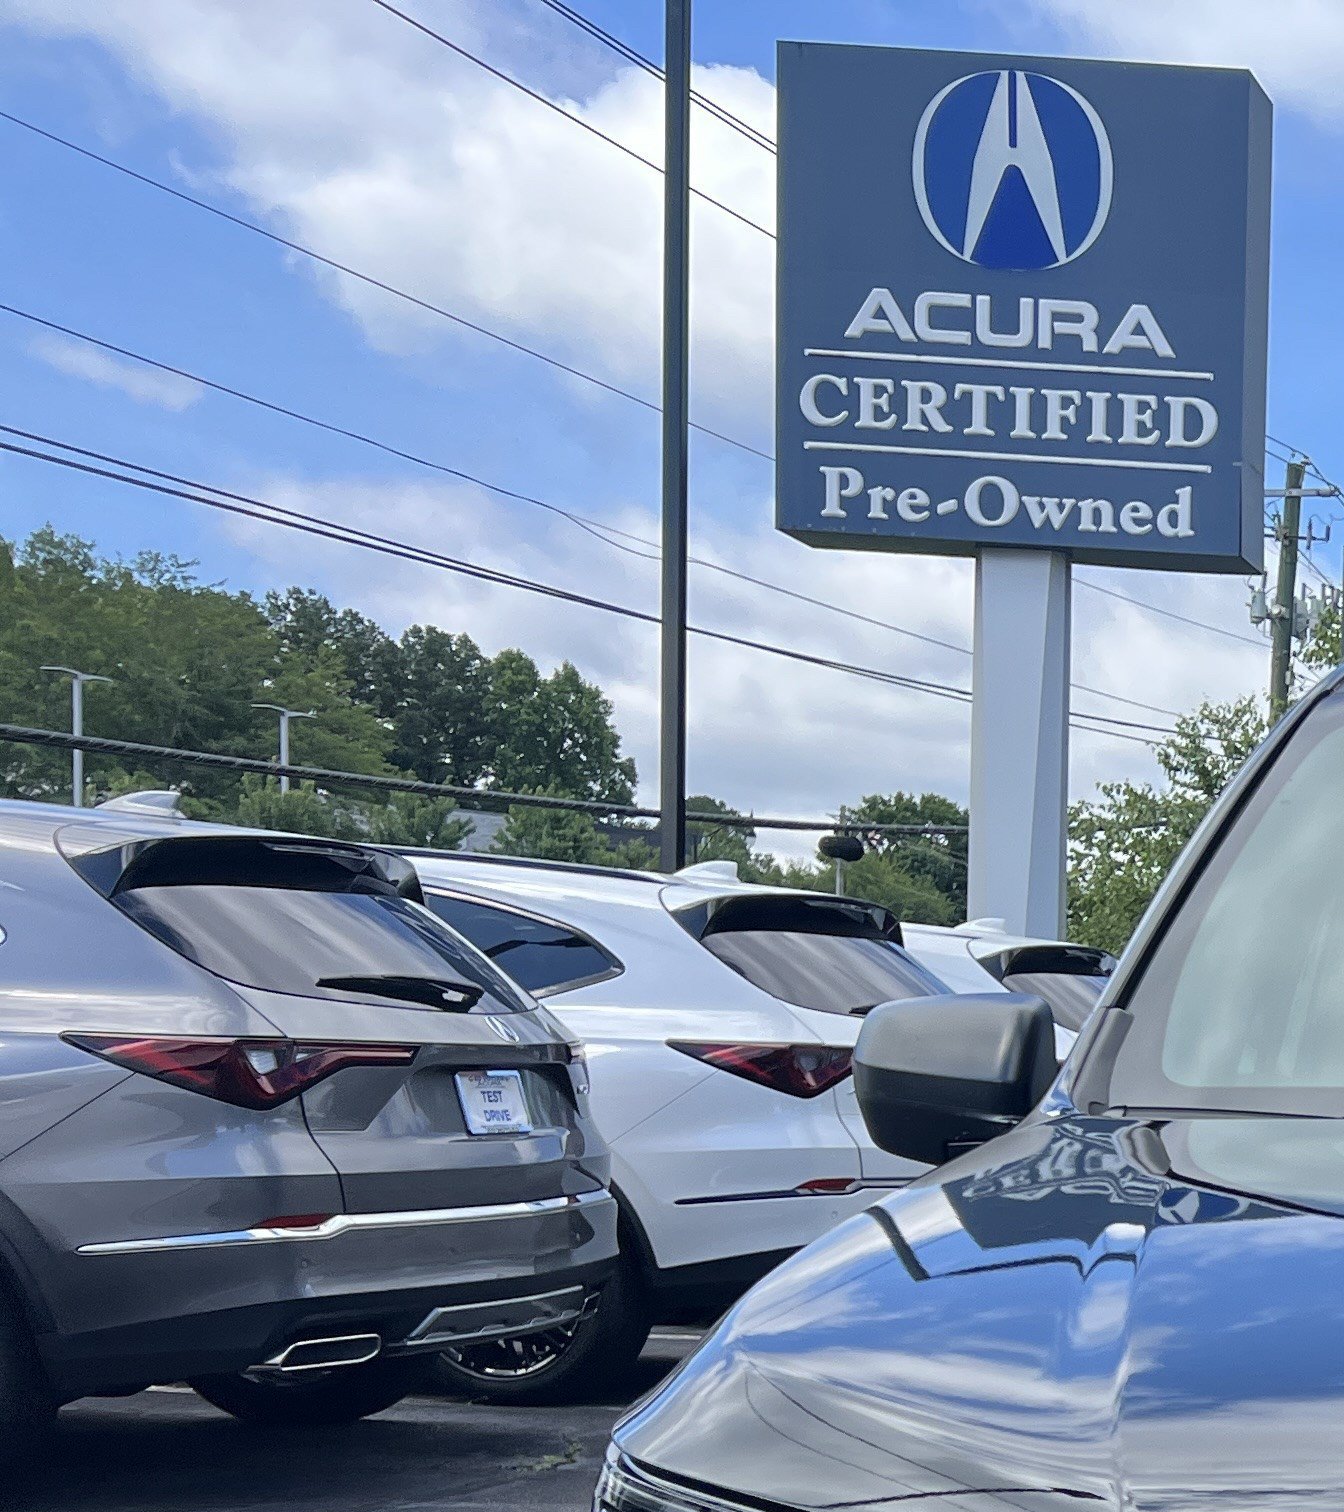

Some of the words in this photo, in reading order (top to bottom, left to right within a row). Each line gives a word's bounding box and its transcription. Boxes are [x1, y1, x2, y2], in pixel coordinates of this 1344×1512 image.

[843, 287, 1177, 359] ACURA
[799, 374, 1220, 449] CERTIFIED
[819, 465, 1195, 540] Pre-Owned
[480, 1090, 503, 1103] TEST
[483, 1109, 511, 1121] DRIVE
